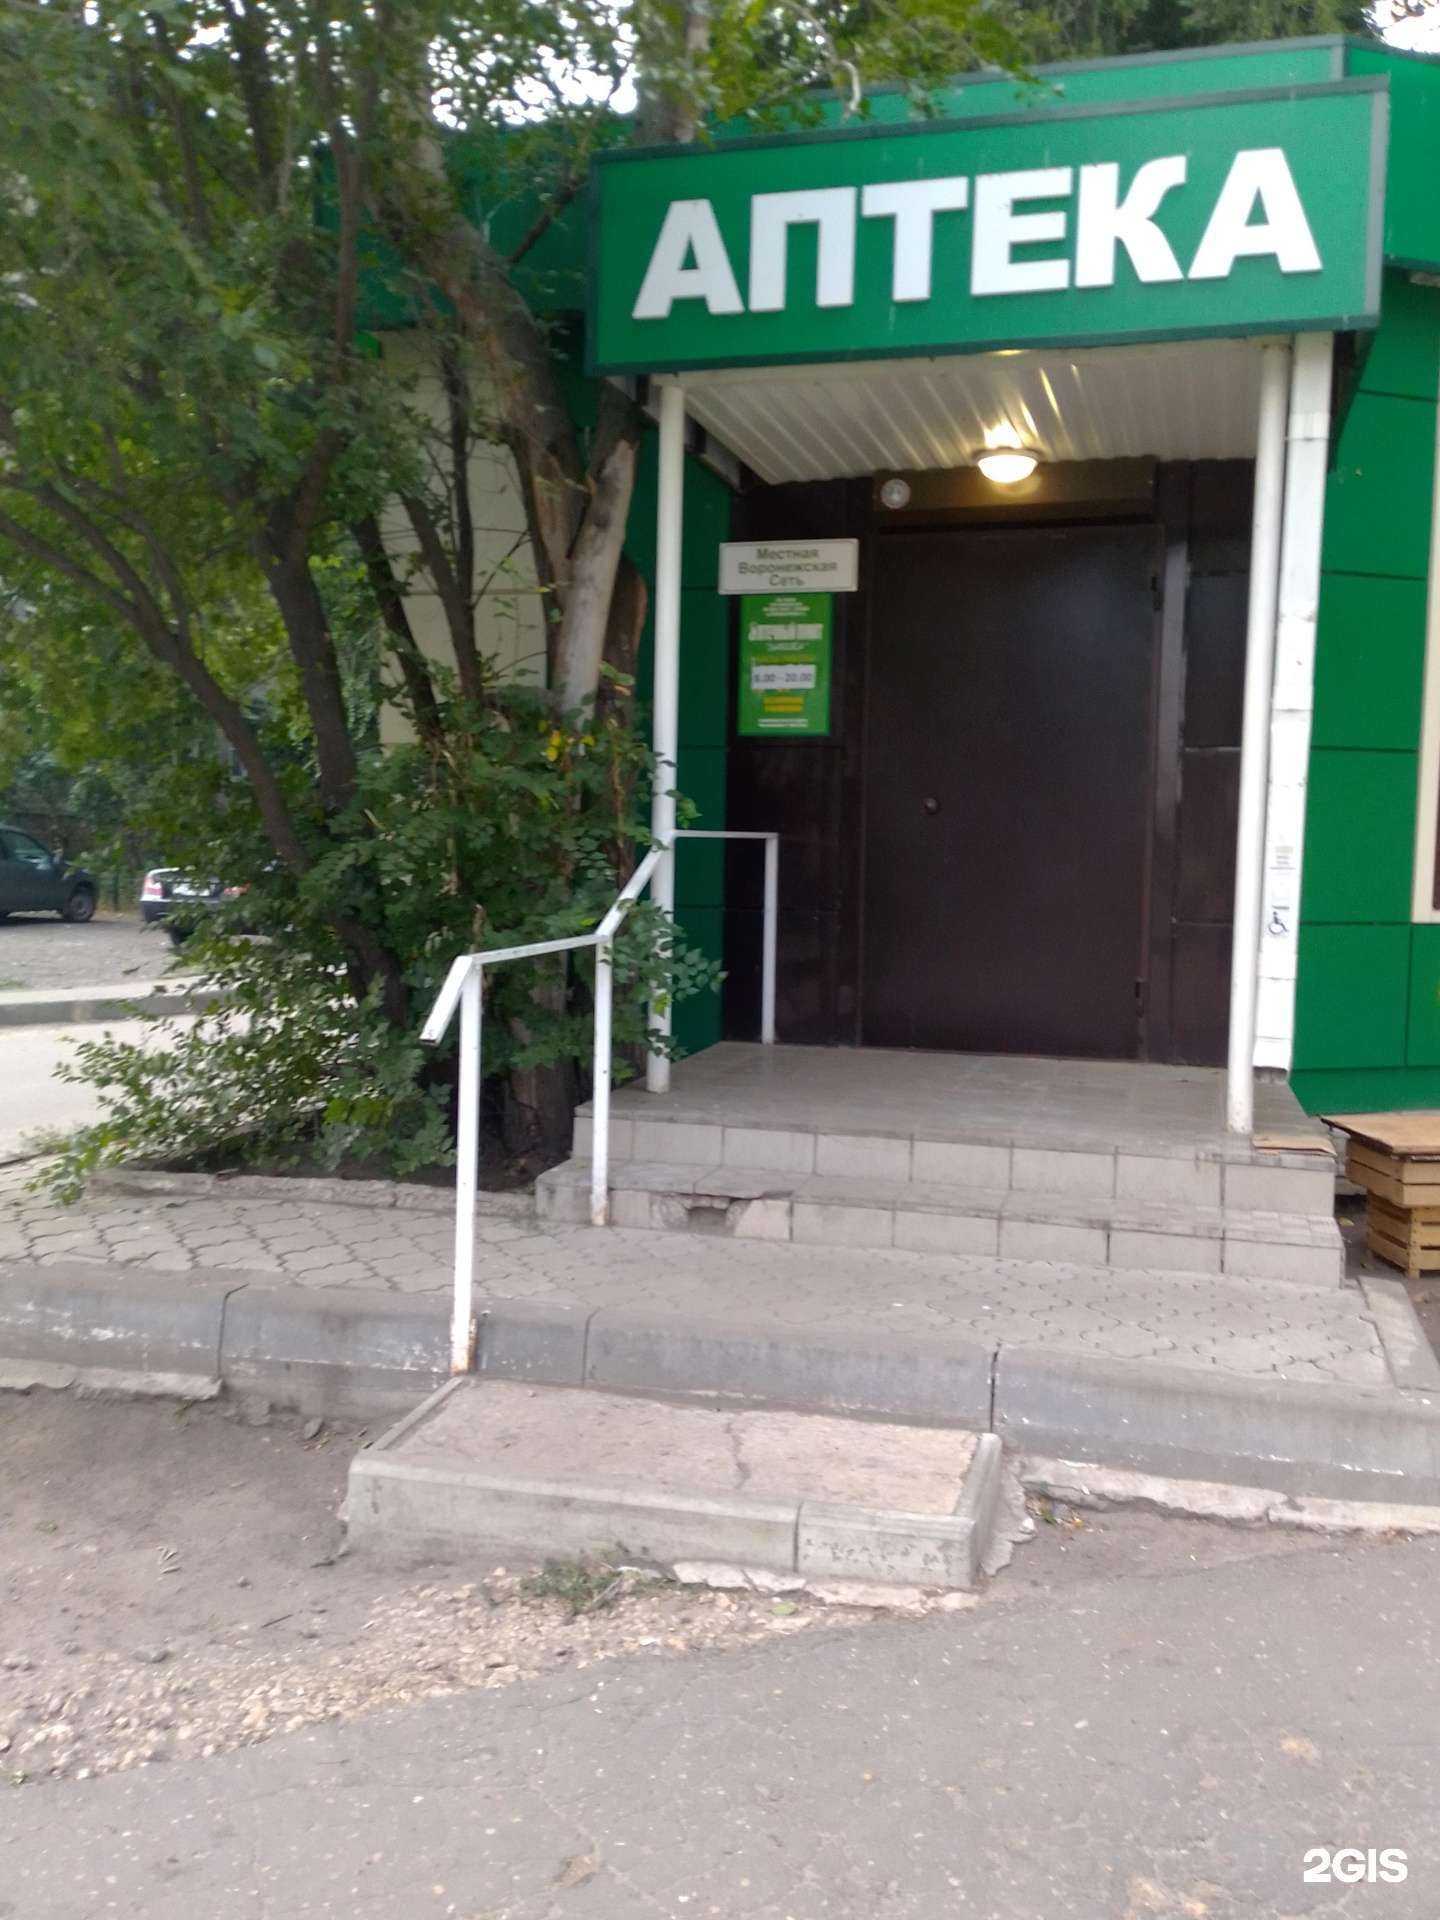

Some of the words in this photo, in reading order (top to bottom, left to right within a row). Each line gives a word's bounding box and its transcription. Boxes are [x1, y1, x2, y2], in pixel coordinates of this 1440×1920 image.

[632, 148, 1323, 319] АПТЕКА
[757, 548, 818, 560] Местная
[738, 561, 837, 575] Воронежская
[769, 574, 806, 586] Сеть
